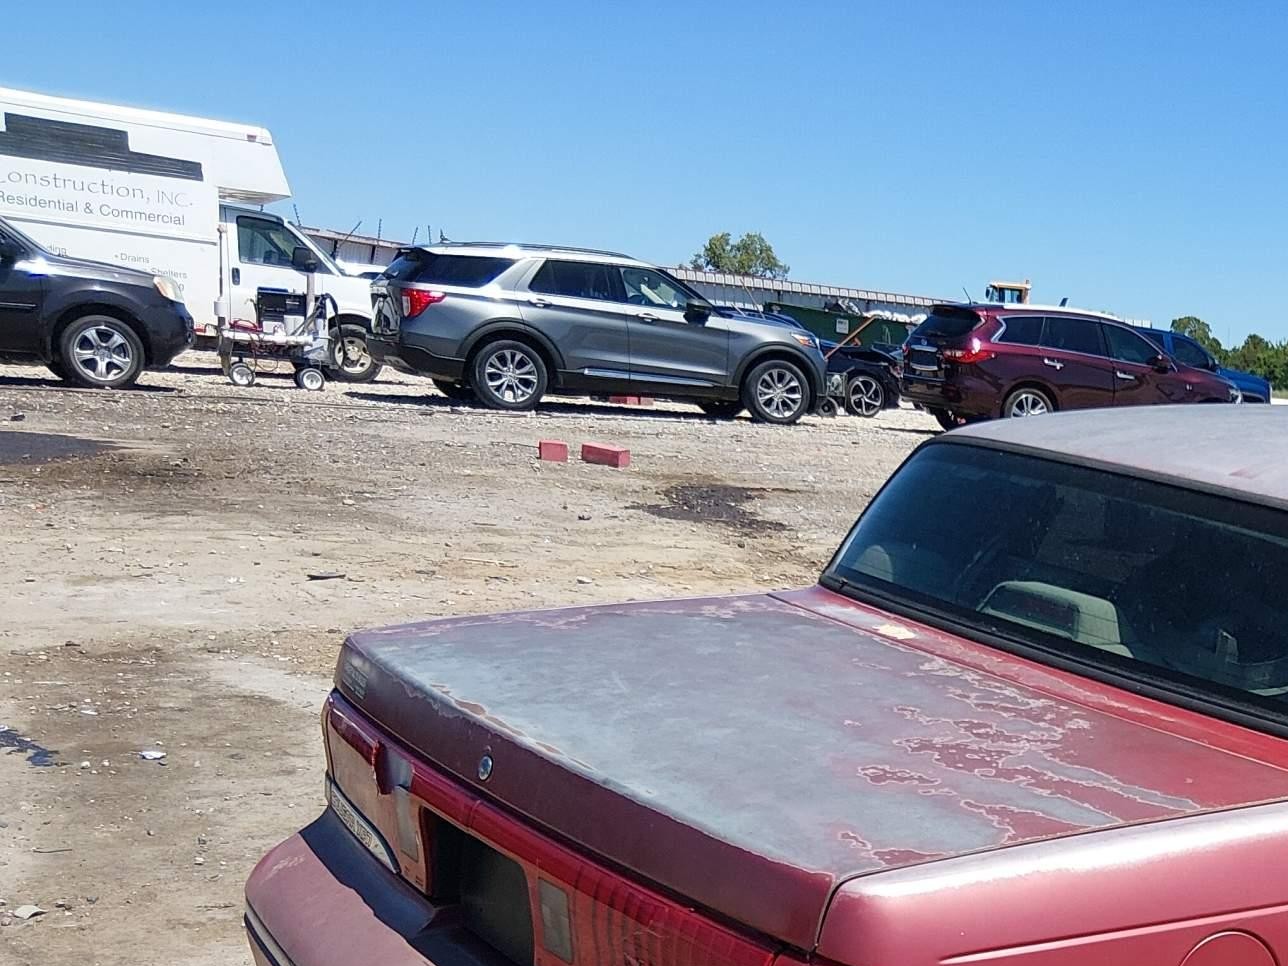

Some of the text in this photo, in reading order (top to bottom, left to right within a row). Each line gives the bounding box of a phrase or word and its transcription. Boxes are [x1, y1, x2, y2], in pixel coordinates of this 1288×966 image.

[0, 170, 193, 207] onstruction, INC.
[83, 202, 94, 215] &
[100, 204, 185, 226] Commercial
[120, 252, 150, 264] Drains
